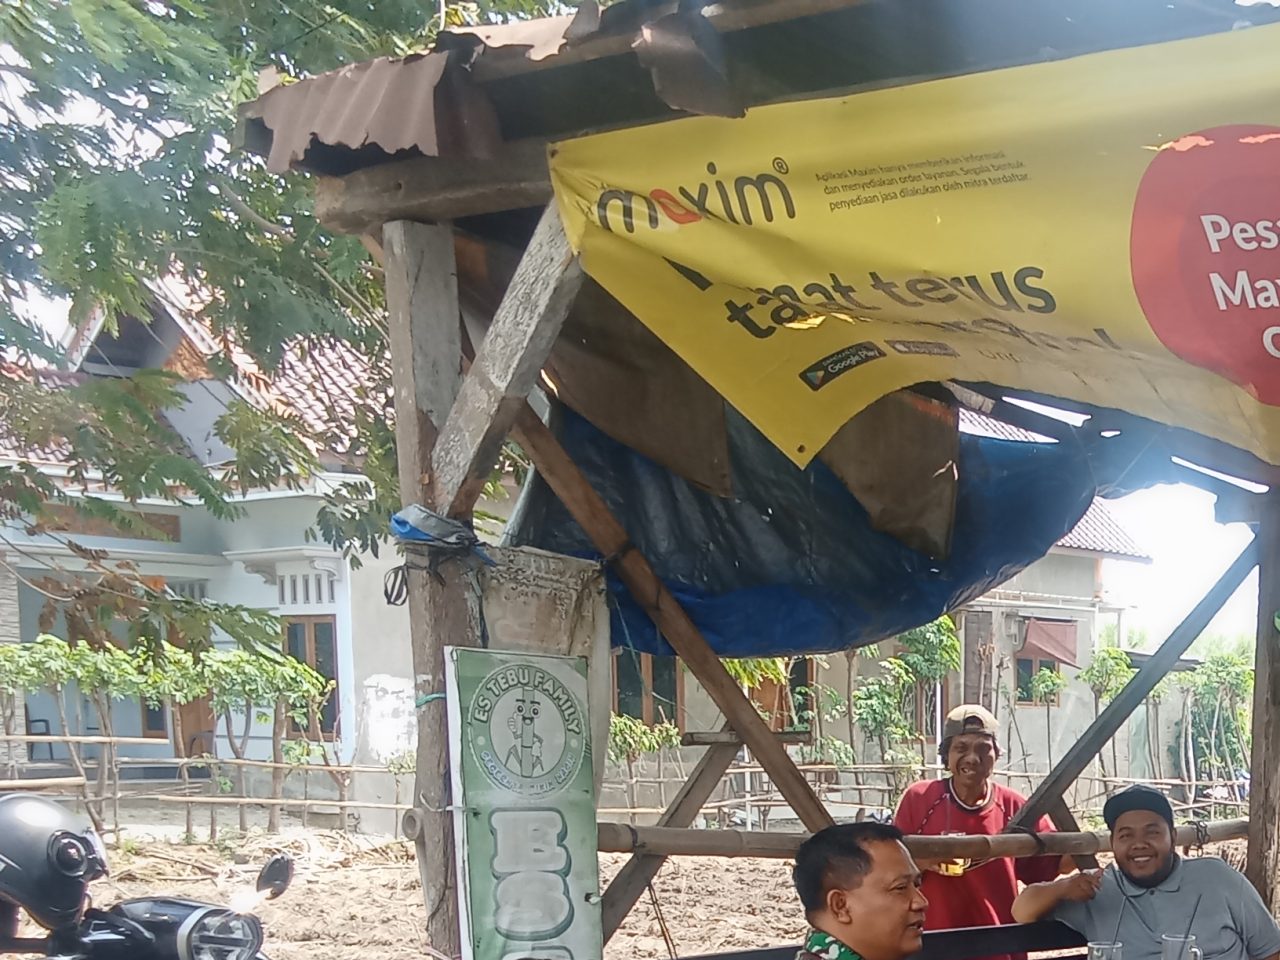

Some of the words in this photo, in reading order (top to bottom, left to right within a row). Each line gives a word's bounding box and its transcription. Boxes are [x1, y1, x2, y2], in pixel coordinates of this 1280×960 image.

[823, 184, 840, 195] dan
[829, 193, 880, 213] penyediaan
[880, 190, 898, 204] jasa
[473, 694, 492, 724] ES
[486, 667, 531, 697] TEBU
[534, 670, 582, 735] FAMILY
